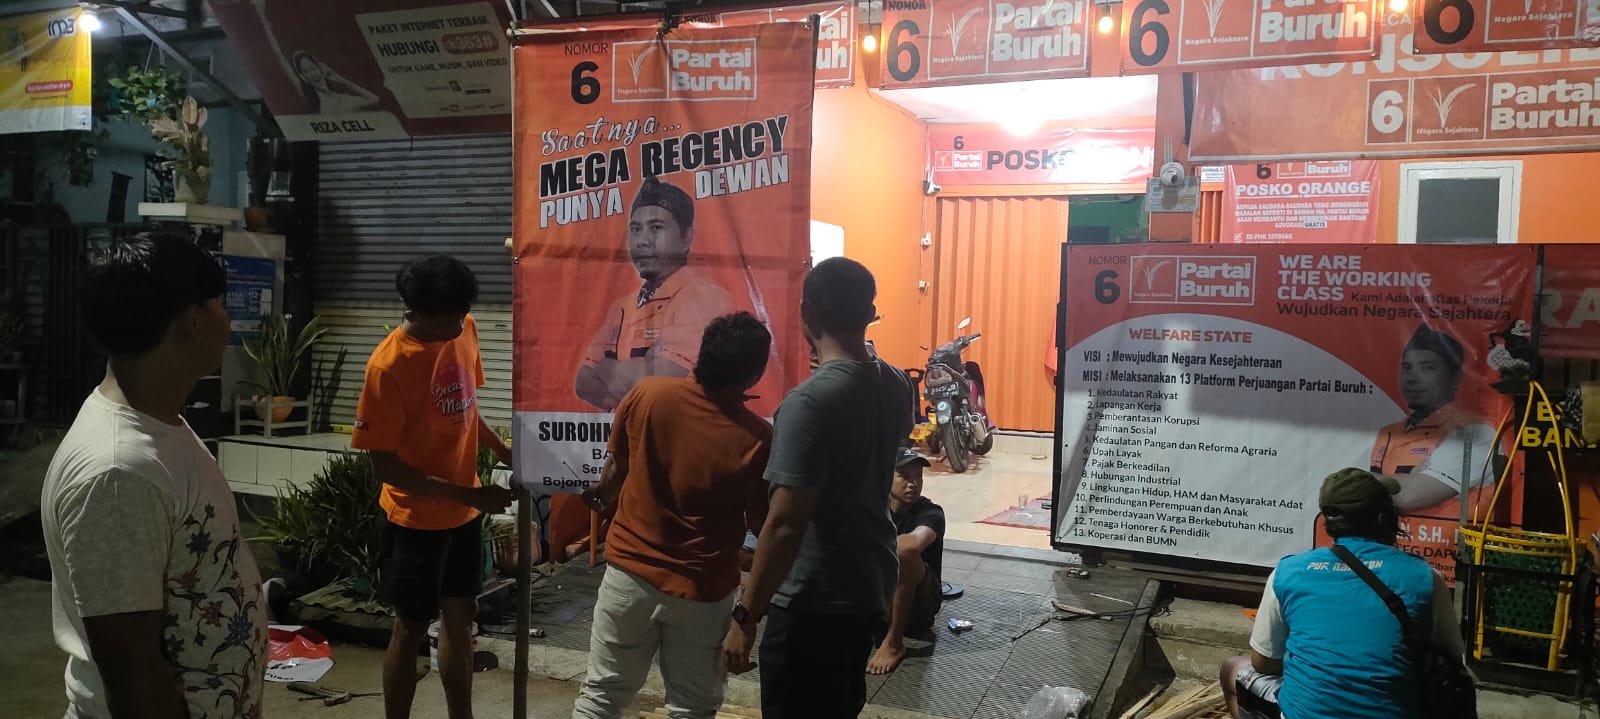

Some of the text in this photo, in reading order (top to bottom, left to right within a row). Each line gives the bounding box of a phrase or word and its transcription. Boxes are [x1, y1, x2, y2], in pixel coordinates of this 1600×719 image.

[368, 16, 490, 35] PAKET INTERNET TERBAIK
[1259, 4, 1367, 43] Buruh
[1494, 14, 1527, 23] Negara
[1129, 0, 1170, 66] 6
[376, 40, 440, 57] HUBUNGI
[565, 42, 608, 56] NOMOR
[887, 20, 920, 81] 6
[993, 26, 1081, 61] Buruh
[388, 65, 412, 74] UNTUK
[466, 60, 483, 68] DAN
[484, 57, 508, 67] VIDEO
[672, 47, 752, 69] Partai
[571, 61, 601, 105] 6
[672, 70, 751, 92] Buruh
[1492, 77, 1600, 106] Partai
[1371, 90, 1404, 134] 6
[1491, 102, 1600, 131] Buruh
[310, 119, 376, 134] RIZA CELL
[1416, 128, 1443, 136] Negara
[953, 136, 964, 150] 6
[539, 114, 789, 199] MEGA REGENCY
[953, 153, 981, 161] Partai
[953, 160, 980, 168] Buruh
[1256, 164, 1272, 179] 6
[1307, 165, 1348, 174] Buruh
[539, 154, 790, 230] PUNYA DEWAN
[1235, 181, 1371, 197] POSKO ORANGE
[1088, 255, 1127, 265] NOMOR
[1279, 254, 1361, 269] WE ARE
[1181, 262, 1251, 279] Partai
[1278, 270, 1432, 287] THE WORKING
[1095, 269, 1121, 305] 6
[1180, 280, 1250, 298] Buruh
[1277, 286, 1344, 300] CLASS
[1351, 292, 1383, 303] Kami
[1277, 302, 1511, 321] Wujudkan Negara Sejahtera
[1129, 328, 1253, 343] WELFARE STATE
[1084, 350, 1283, 369] VISI Mewujudkan Negara Kesejahteraan
[1082, 370, 1367, 394] MISI Melaksanakan 13 Platform Perjuangan Partai Buruh
[1088, 389, 1178, 400] 1. Kedaulatan Rakyat
[1087, 401, 1162, 412] 2. Lapangan Kerja
[1094, 412, 1200, 426] Pemberantasan Korupsi
[1094, 423, 1129, 434] Jaminan
[1130, 425, 1157, 435] Sosial
[1092, 447, 1114, 457] Upah
[1116, 449, 1142, 458] Layak
[1093, 435, 1142, 446] Kedaulatan
[1144, 439, 1177, 449] Pangan
[1179, 441, 1197, 450] dan
[1198, 442, 1239, 453] Reforma
[1241, 446, 1278, 457] Agraria
[1091, 458, 1114, 470] Pajak
[1116, 460, 1170, 473] Berkeadilan
[543, 476, 590, 489] Bojong
[1091, 471, 1135, 482] Hubungan
[1137, 474, 1181, 486] Industrial
[1090, 482, 1140, 495] Lingkungan
[1142, 487, 1171, 498] Hidup,
[1173, 490, 1198, 500] HAM
[1200, 492, 1218, 501] dan
[1219, 493, 1277, 507] Masyarakat
[1279, 500, 1304, 510] Adat
[1076, 493, 1248, 517] 10. Perlindungan Perempuan dan Anak
[1074, 517, 1210, 538] 12. Tenaga Honorer & Pendidik
[1075, 505, 1294, 534] 11. Pemberdayaan Warga Berkebutuhan Khusus
[1073, 528, 1177, 547] 13. Koperasi dan BUMN
[1306, 561, 1330, 570] PUK
